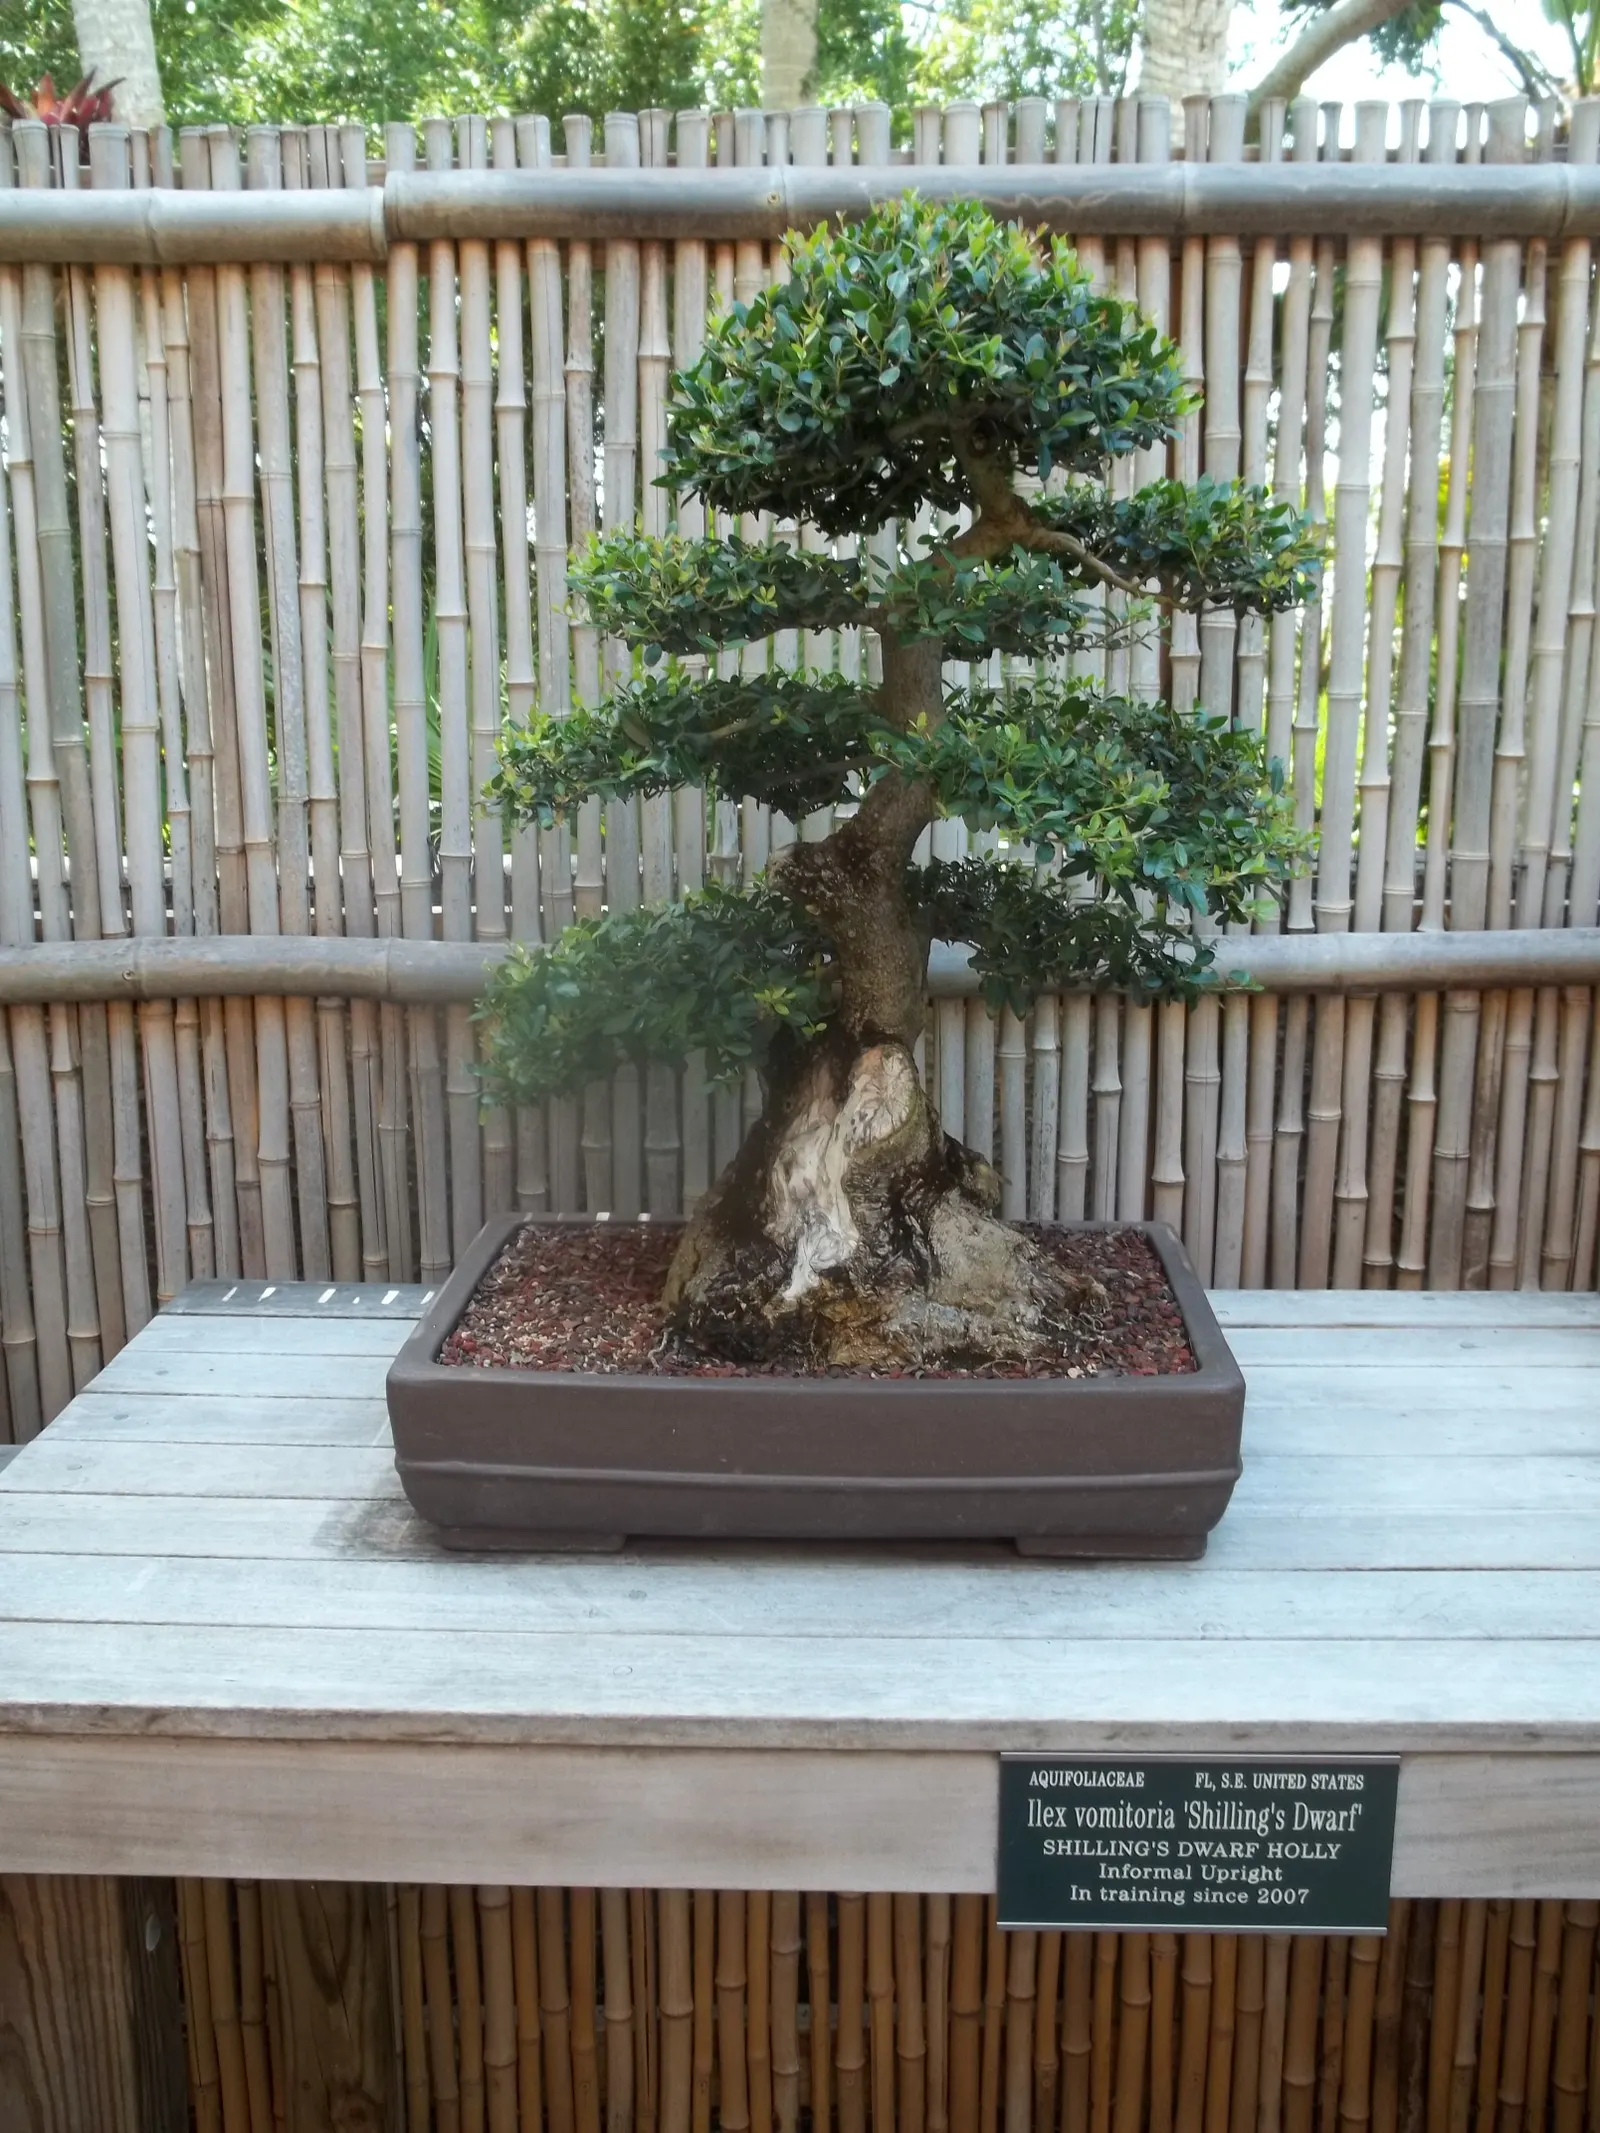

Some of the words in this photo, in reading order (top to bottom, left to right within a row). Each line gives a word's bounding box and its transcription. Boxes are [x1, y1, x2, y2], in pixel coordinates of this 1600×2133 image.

[1029, 1770, 1144, 1788] AQUIFOLIACEAE
[1195, 1773, 1216, 1792] FL,
[1221, 1773, 1247, 1788] S.E.
[1253, 1773, 1306, 1789] UNITED
[1311, 1774, 1364, 1790] STATES
[1028, 1799, 1066, 1827] Ilex
[1075, 1800, 1175, 1829] vomitoria
[1185, 1801, 1285, 1837] 'Shilling's
[1293, 1802, 1362, 1831] Dwarf'
[1044, 1839, 1169, 1856] SHILLING'S
[1178, 1842, 1259, 1858] DWARF
[1267, 1843, 1341, 1859] HOLLY
[1099, 1863, 1192, 1879] Informal
[1201, 1865, 1282, 1883] Upright
[1071, 1885, 1091, 1900] In
[1100, 1887, 1185, 1905] training
[1194, 1888, 1248, 1903] since
[1258, 1888, 1309, 1904] 2007
